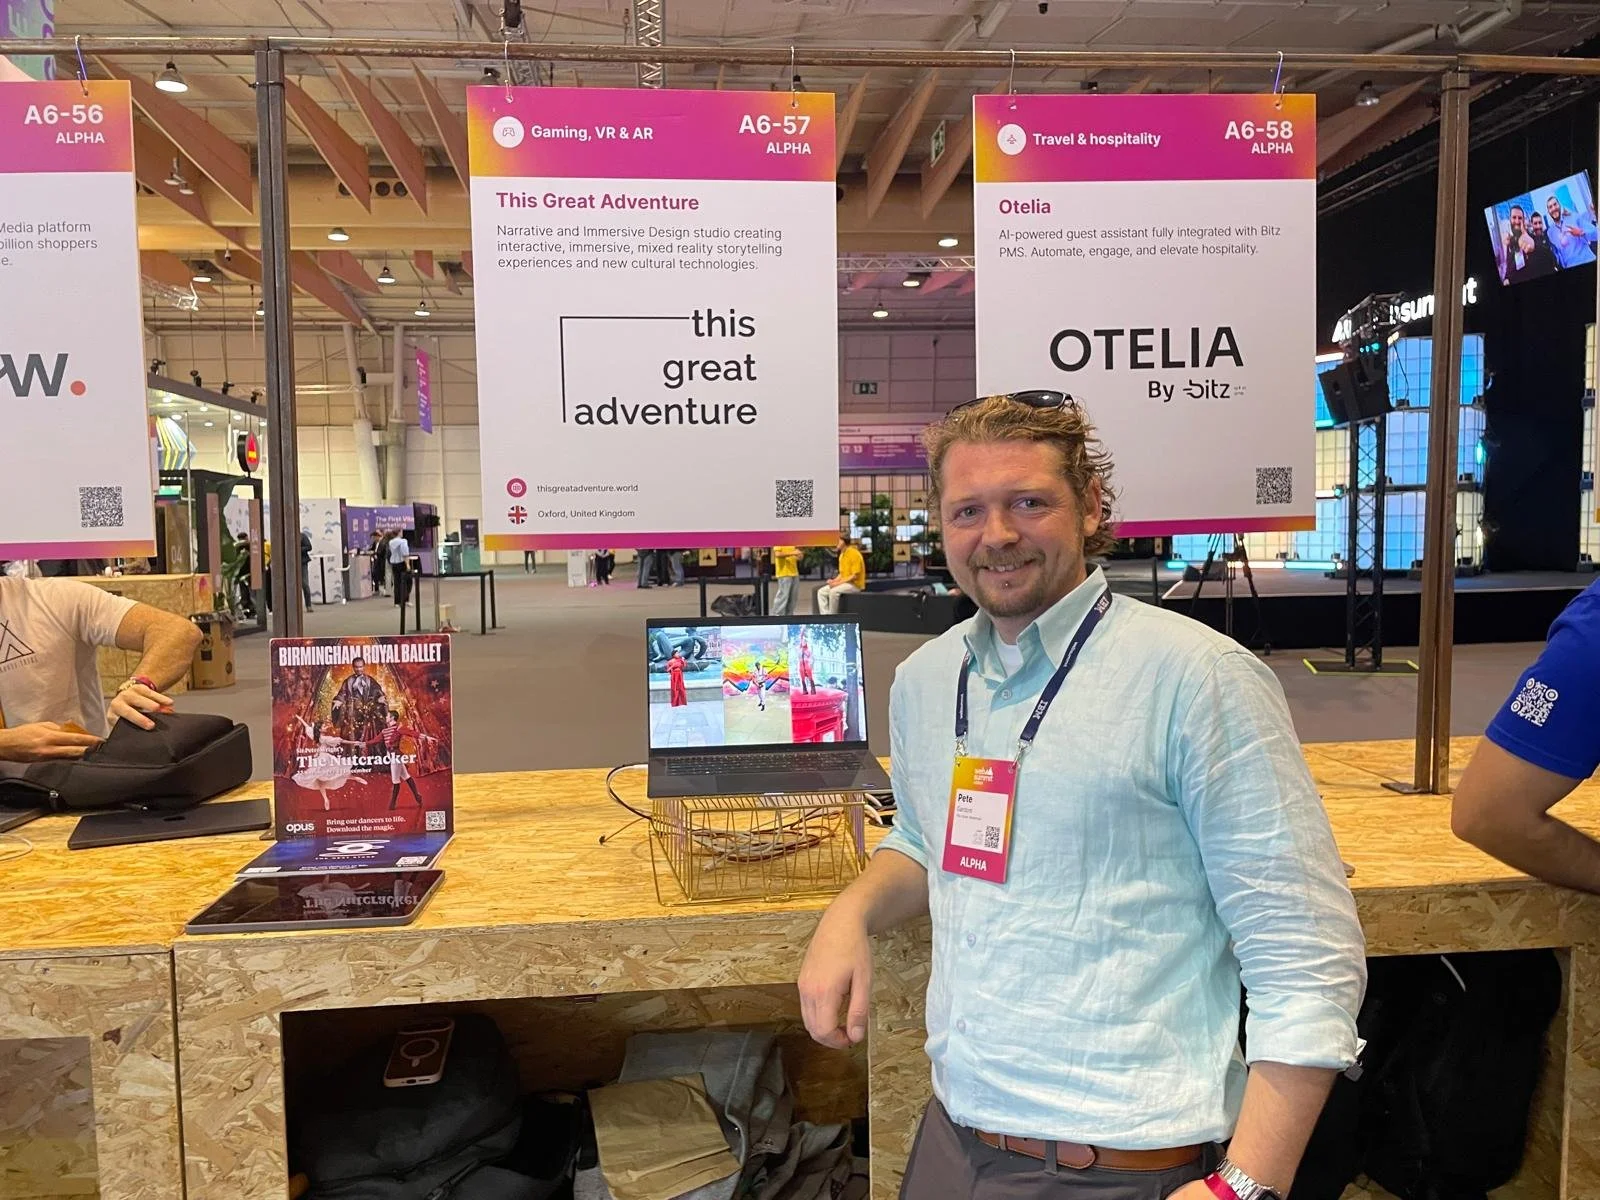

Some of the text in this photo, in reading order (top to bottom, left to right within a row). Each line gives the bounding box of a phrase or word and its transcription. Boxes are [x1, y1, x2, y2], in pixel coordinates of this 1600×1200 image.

[24, 104, 104, 125] A6-56
[531, 125, 653, 141] Gaming, VR & AR
[739, 115, 811, 135] A6-57
[1224, 121, 1293, 140] A6-58
[56, 132, 105, 144] ALPHA
[1033, 132, 1161, 148] Travel & hospitality
[766, 142, 811, 155] ALPHA
[1251, 142, 1294, 154] ALPHA
[496, 192, 699, 210] This Great Adventure
[999, 198, 1051, 214] Otelia
[37, 221, 91, 235] platform
[497, 225, 782, 242] Narrative and Immersive Design studio creating
[999, 226, 1281, 241] AI-powered guest assistant fully integrated with Bitz
[37, 238, 98, 251] shoppers
[497, 241, 782, 257] interactive, immersive, mixed reality storytelling
[999, 243, 1258, 258] PMS. Automate, engage, and elevate hospitality.
[498, 257, 758, 272] experiences and new cultural technologies.
[692, 309, 756, 337] this
[1049, 326, 1244, 372] OTELIA
[663, 354, 757, 389] great
[1148, 380, 1174, 402] By
[574, 397, 757, 425] adventure
[537, 483, 638, 493] thisgreatadventure.world
[538, 509, 635, 520] Oxford, United Kingdom
[279, 643, 442, 667] BIRMINGHAM ROYAL BALLET
[296, 752, 417, 768] The Nutcracker
[958, 793, 973, 803] Pete
[286, 821, 315, 834] opus
[326, 818, 344, 826] Bring
[373, 824, 395, 832] magic.
[960, 856, 987, 871] ALPHA
